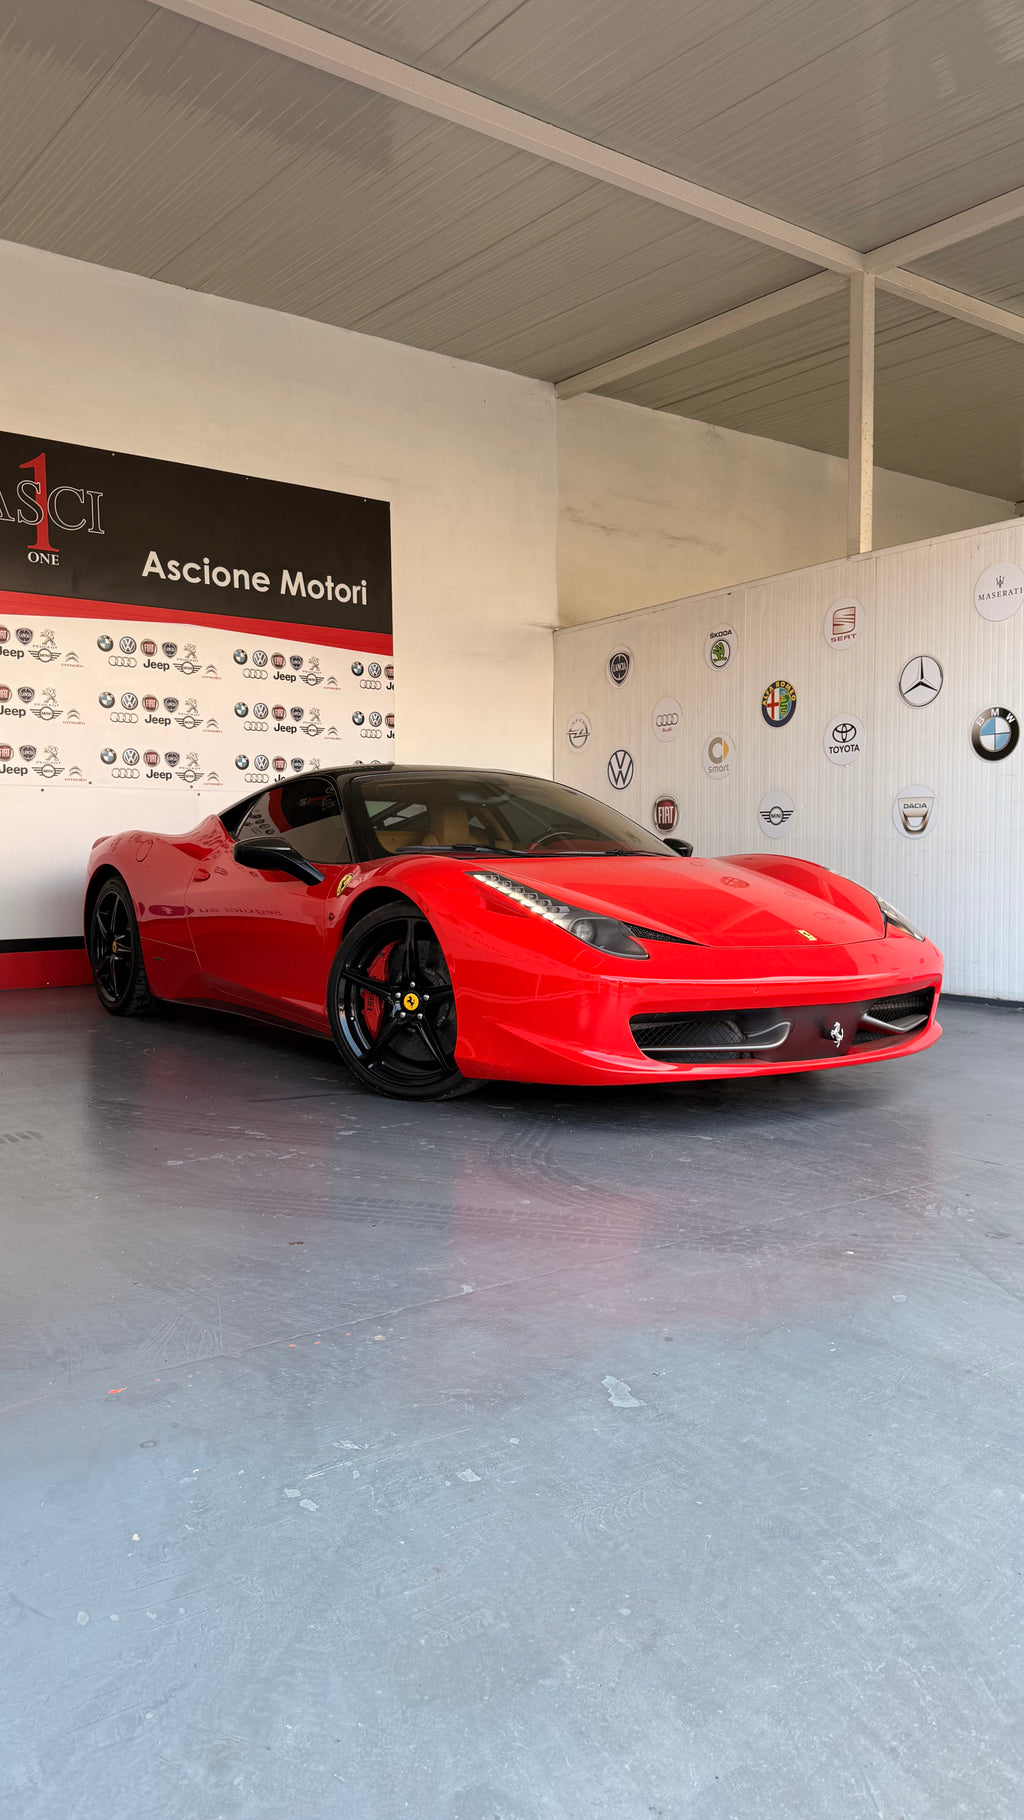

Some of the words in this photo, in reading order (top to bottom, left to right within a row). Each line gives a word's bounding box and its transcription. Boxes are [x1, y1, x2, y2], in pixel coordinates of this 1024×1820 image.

[27, 551, 60, 566] ONE
[141, 550, 271, 593] Ascione
[280, 569, 368, 605] Motori
[978, 587, 1023, 601] MASERATI
[830, 633, 857, 643] SEAT
[143, 658, 170, 672] Jeep
[273, 671, 297, 683] Jeep
[144, 714, 171, 727] Jeep
[273, 722, 297, 735] Jeep
[828, 744, 860, 754] TOYOTA
[0, 764, 28, 777] Jeep
[145, 769, 172, 781] Jeep
[708, 764, 730, 774] smart
[657, 806, 674, 824] FIAT
